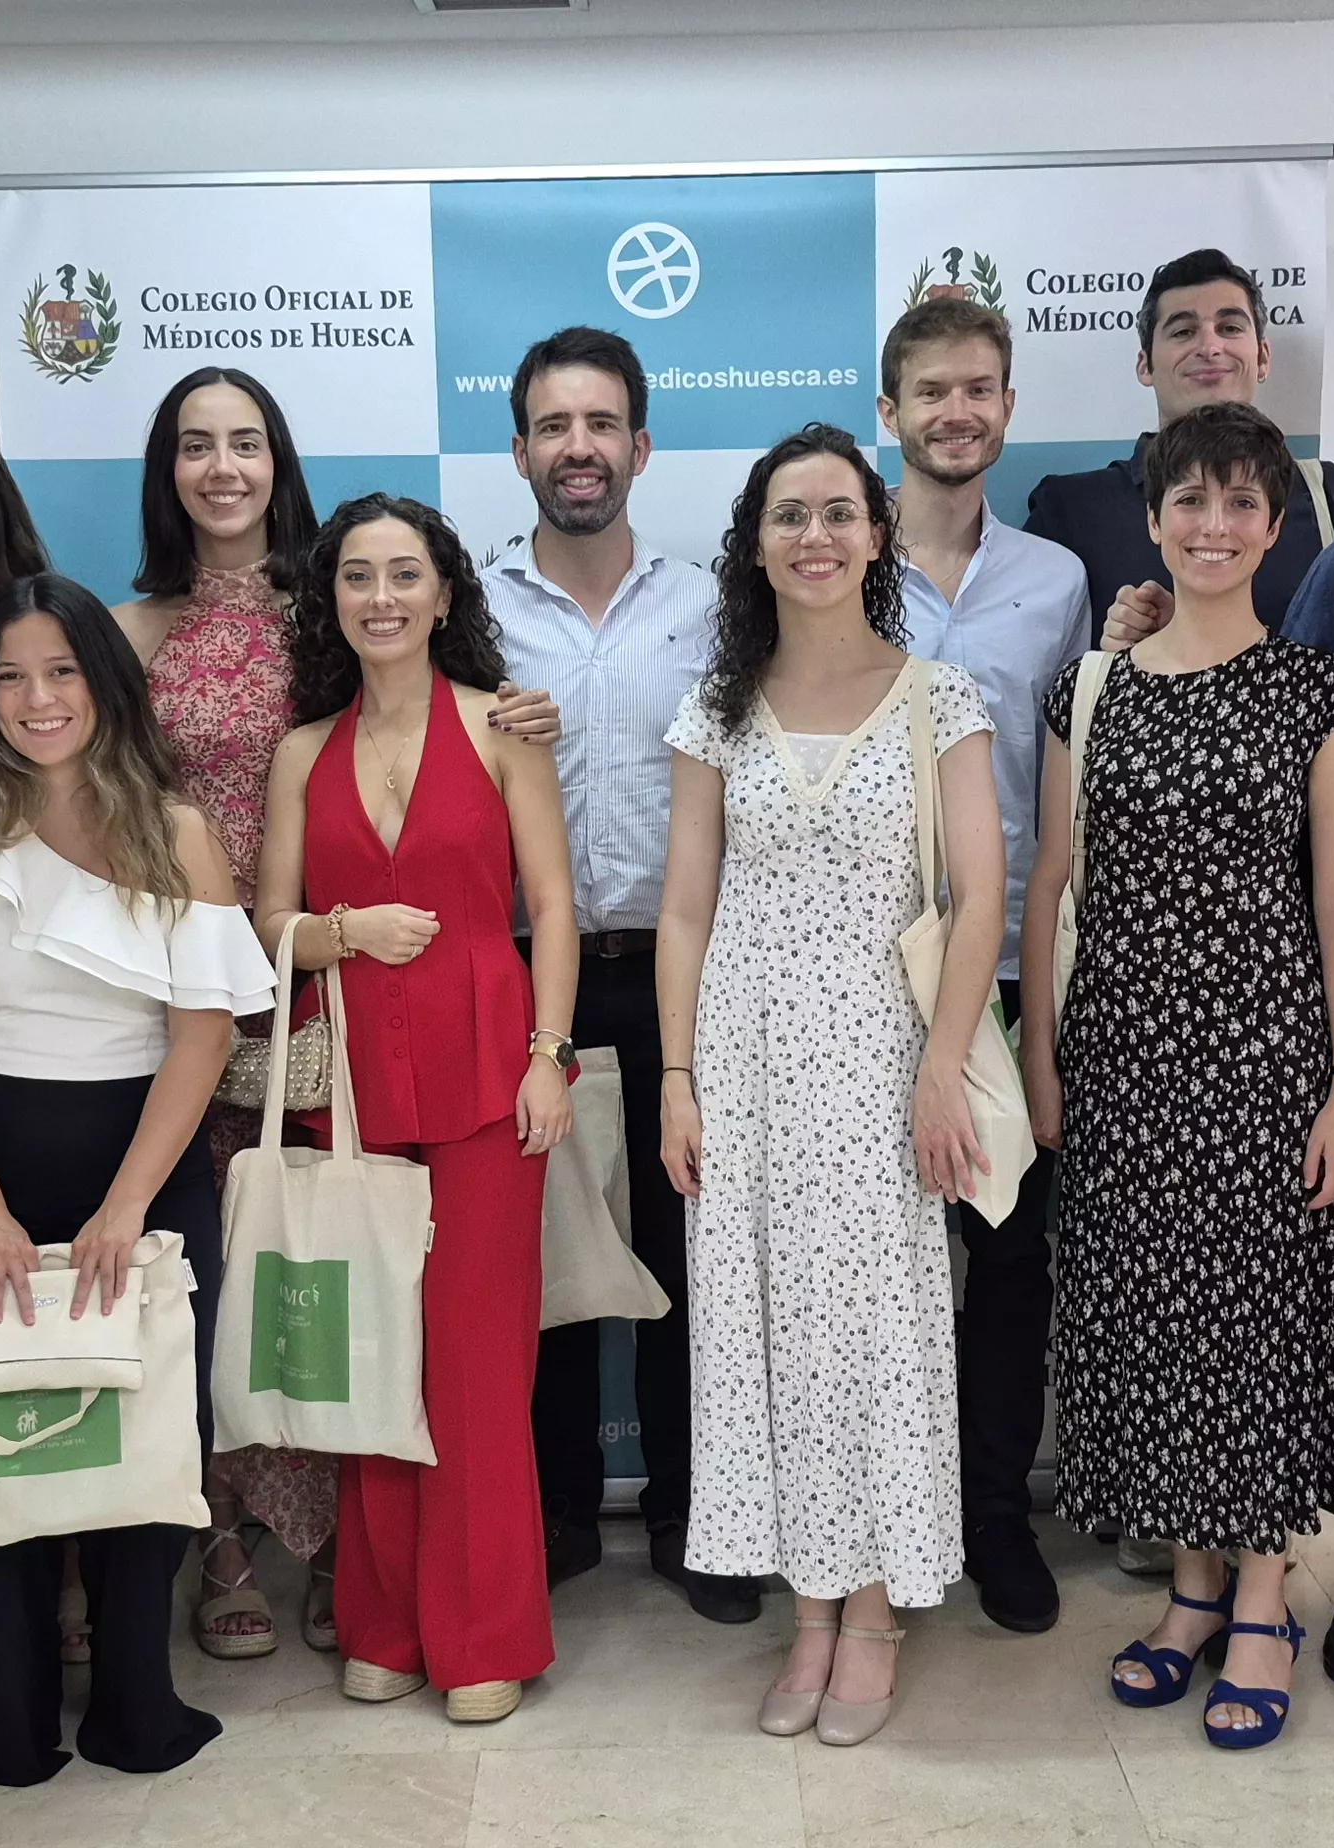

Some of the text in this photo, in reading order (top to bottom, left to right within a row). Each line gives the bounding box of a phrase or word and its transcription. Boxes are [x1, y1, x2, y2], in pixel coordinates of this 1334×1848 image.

[1026, 268, 1145, 295] COLEGIO
[1271, 266, 1307, 287] DE
[140, 284, 414, 313] COLEGIO OFICIAL DE
[1025, 305, 1141, 332] MÉDICO
[142, 322, 416, 350] MÉDICOS DE HUESCA
